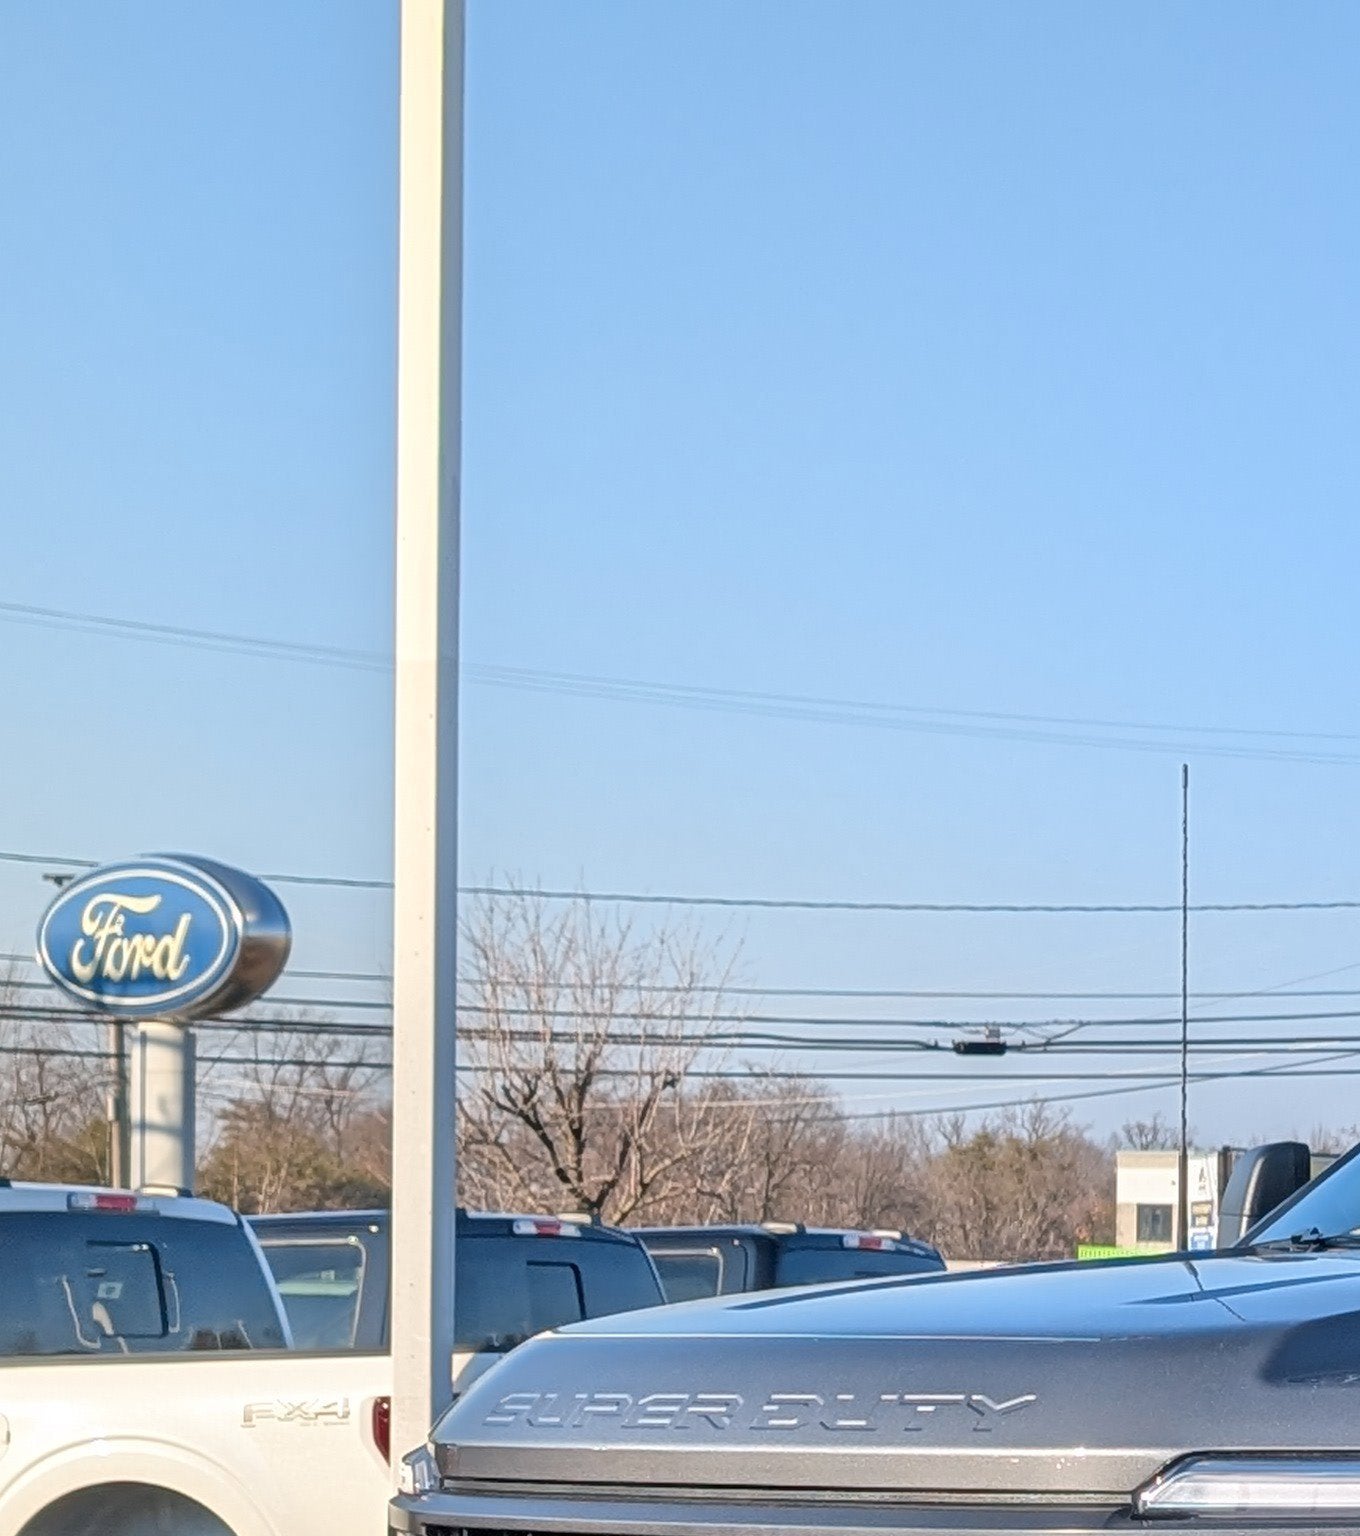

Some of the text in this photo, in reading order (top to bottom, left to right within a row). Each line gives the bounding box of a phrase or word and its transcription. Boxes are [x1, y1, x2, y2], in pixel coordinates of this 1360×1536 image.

[71, 892, 192, 983] Ford
[241, 1397, 350, 1427] FX4
[483, 1392, 1037, 1432] SUPER DUTY
